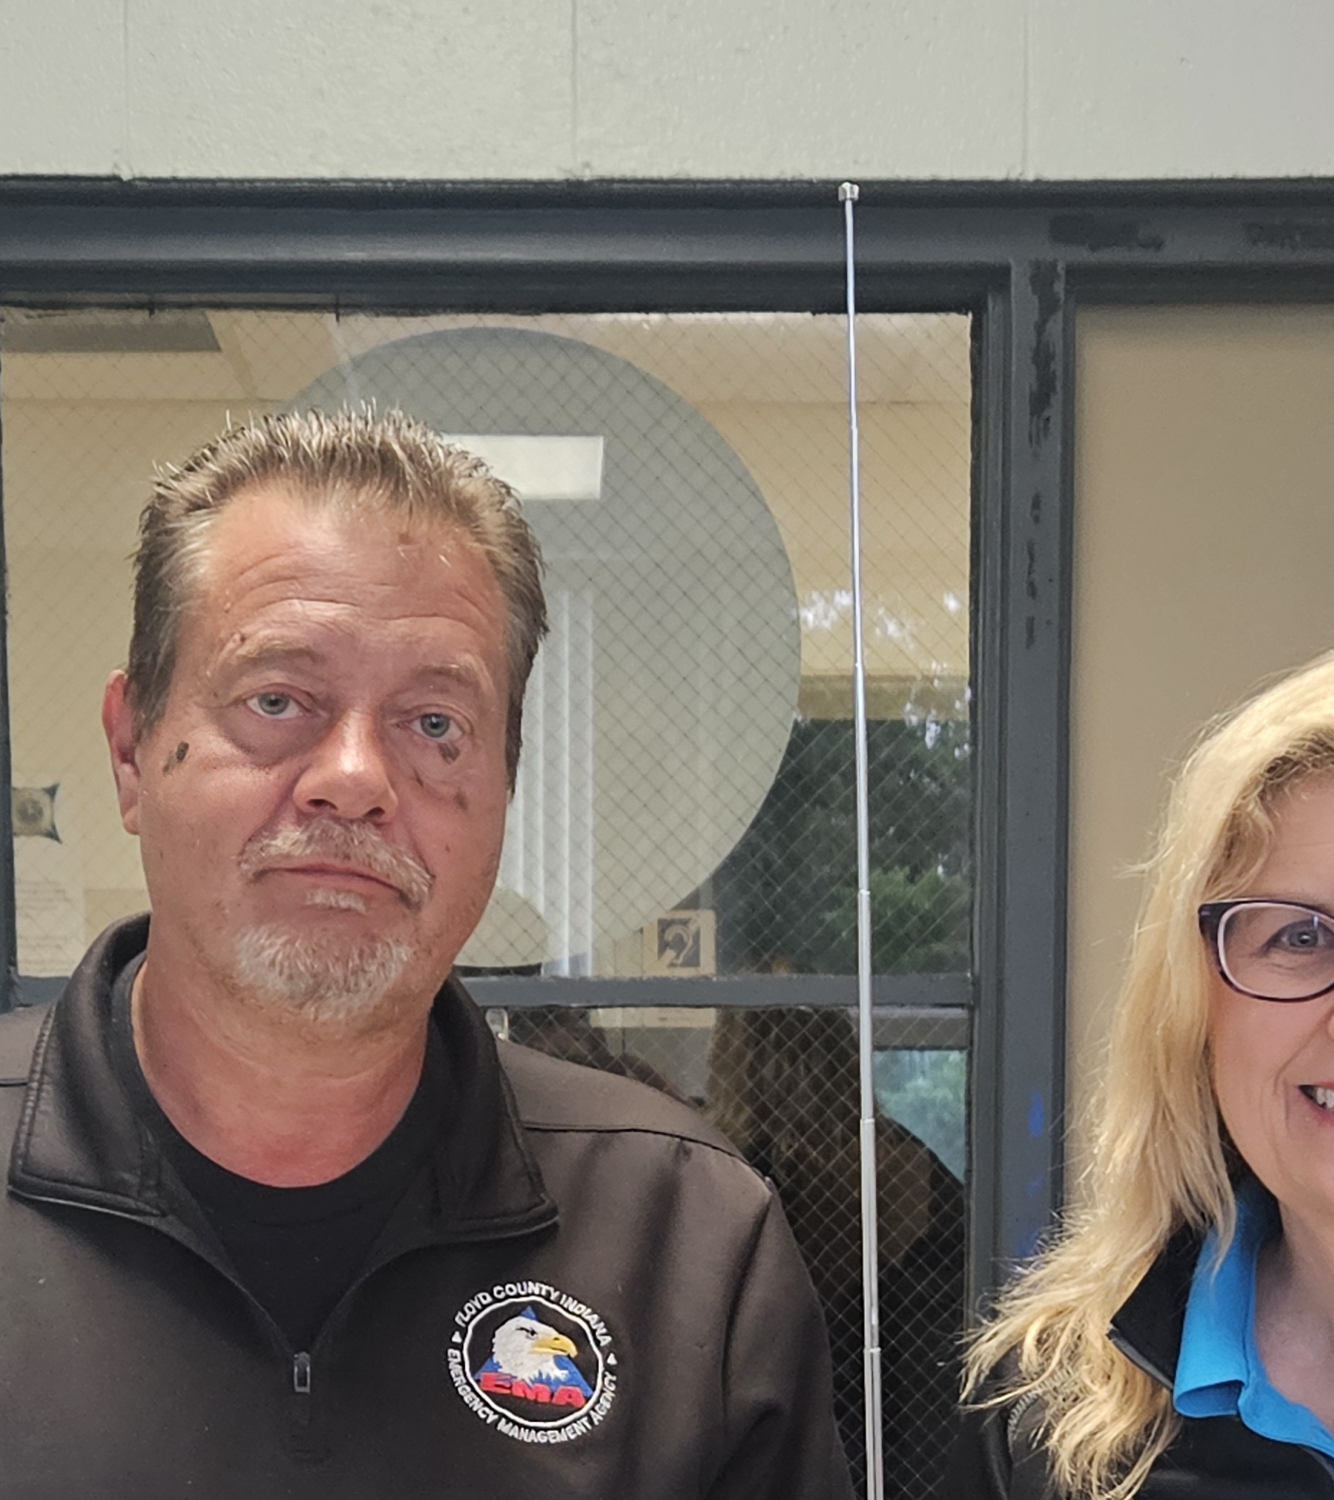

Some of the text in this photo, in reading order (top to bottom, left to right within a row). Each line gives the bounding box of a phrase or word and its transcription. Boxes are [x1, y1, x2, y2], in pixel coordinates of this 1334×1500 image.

[454, 1281, 612, 1347] FLOYD COUNTY INDIANA
[447, 1348, 617, 1444] EMERGENCY MANAGEMENT AGENCY
[480, 1372, 586, 1408] EMA
